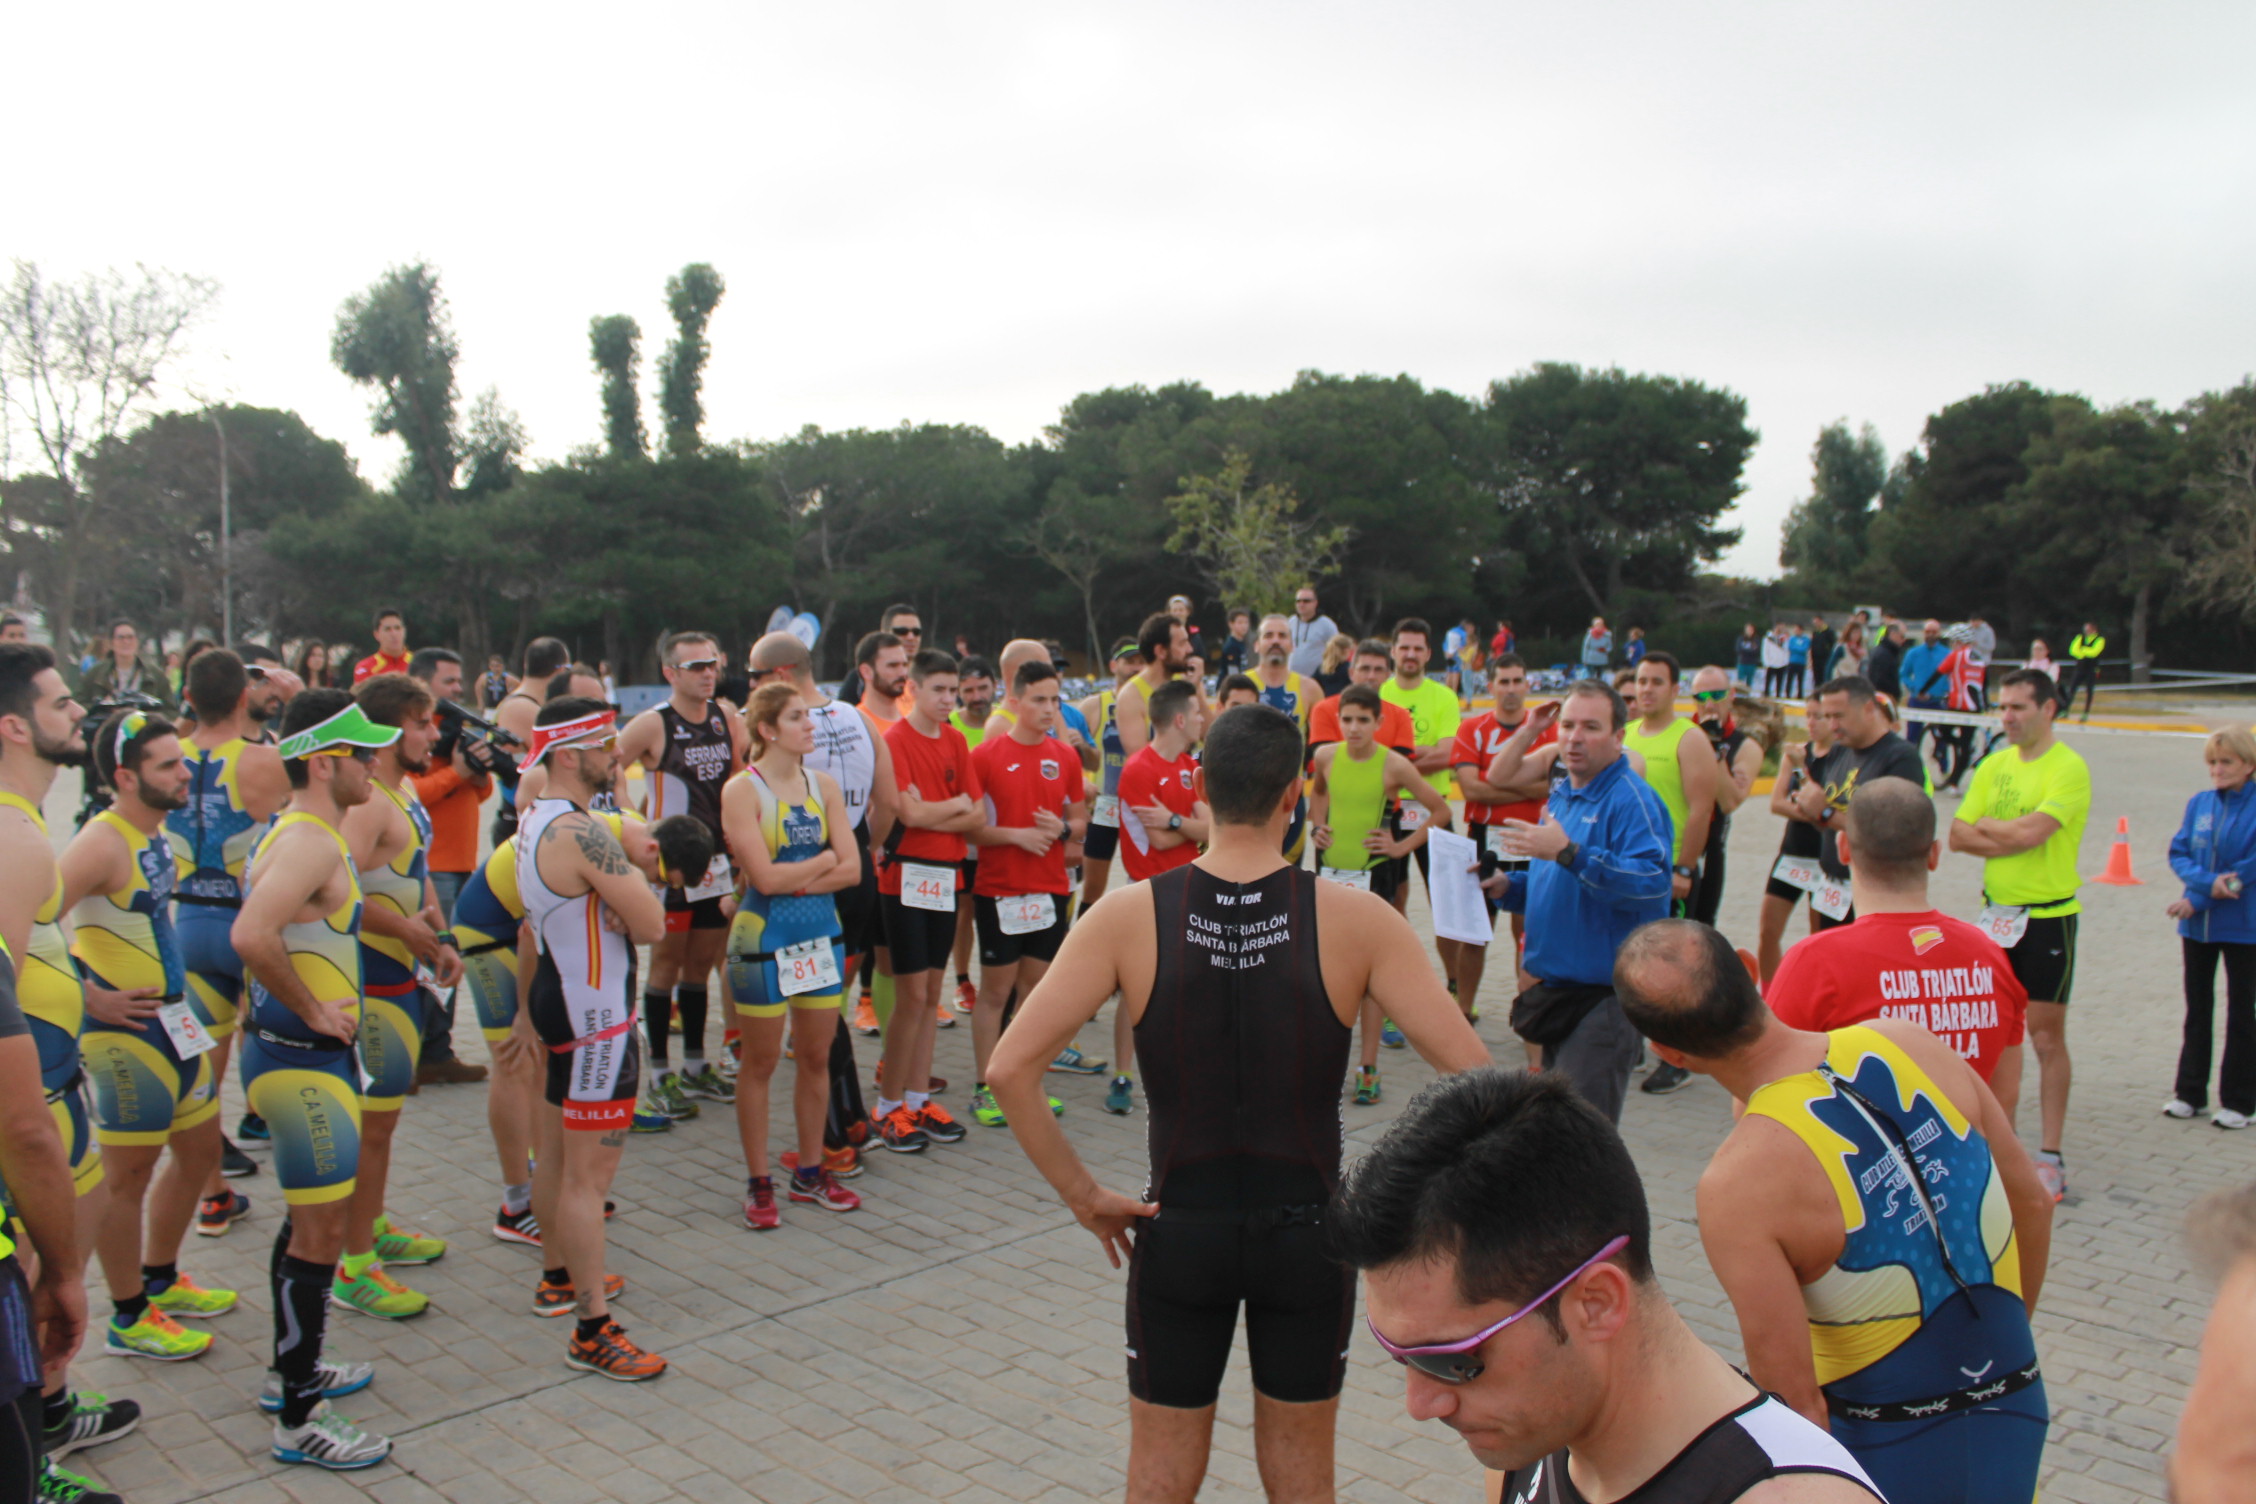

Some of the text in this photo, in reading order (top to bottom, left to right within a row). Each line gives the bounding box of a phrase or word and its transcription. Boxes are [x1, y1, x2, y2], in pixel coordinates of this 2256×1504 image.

[684, 742, 731, 766] SERRANO
[697, 762, 724, 781] ESP
[916, 879, 942, 899] 44
[1016, 903, 1041, 922] 42
[1189, 913, 1222, 935] CLUB
[1186, 929, 1290, 954] SANTA BÁRBARA
[793, 957, 818, 980] 81
[1211, 953, 1265, 970] MELILLA
[1880, 959, 1994, 1000] CLUB TRIATLÓN
[1930, 997, 1998, 1032] BÁRBARA
[308, 1111, 338, 1176] MELILLA
